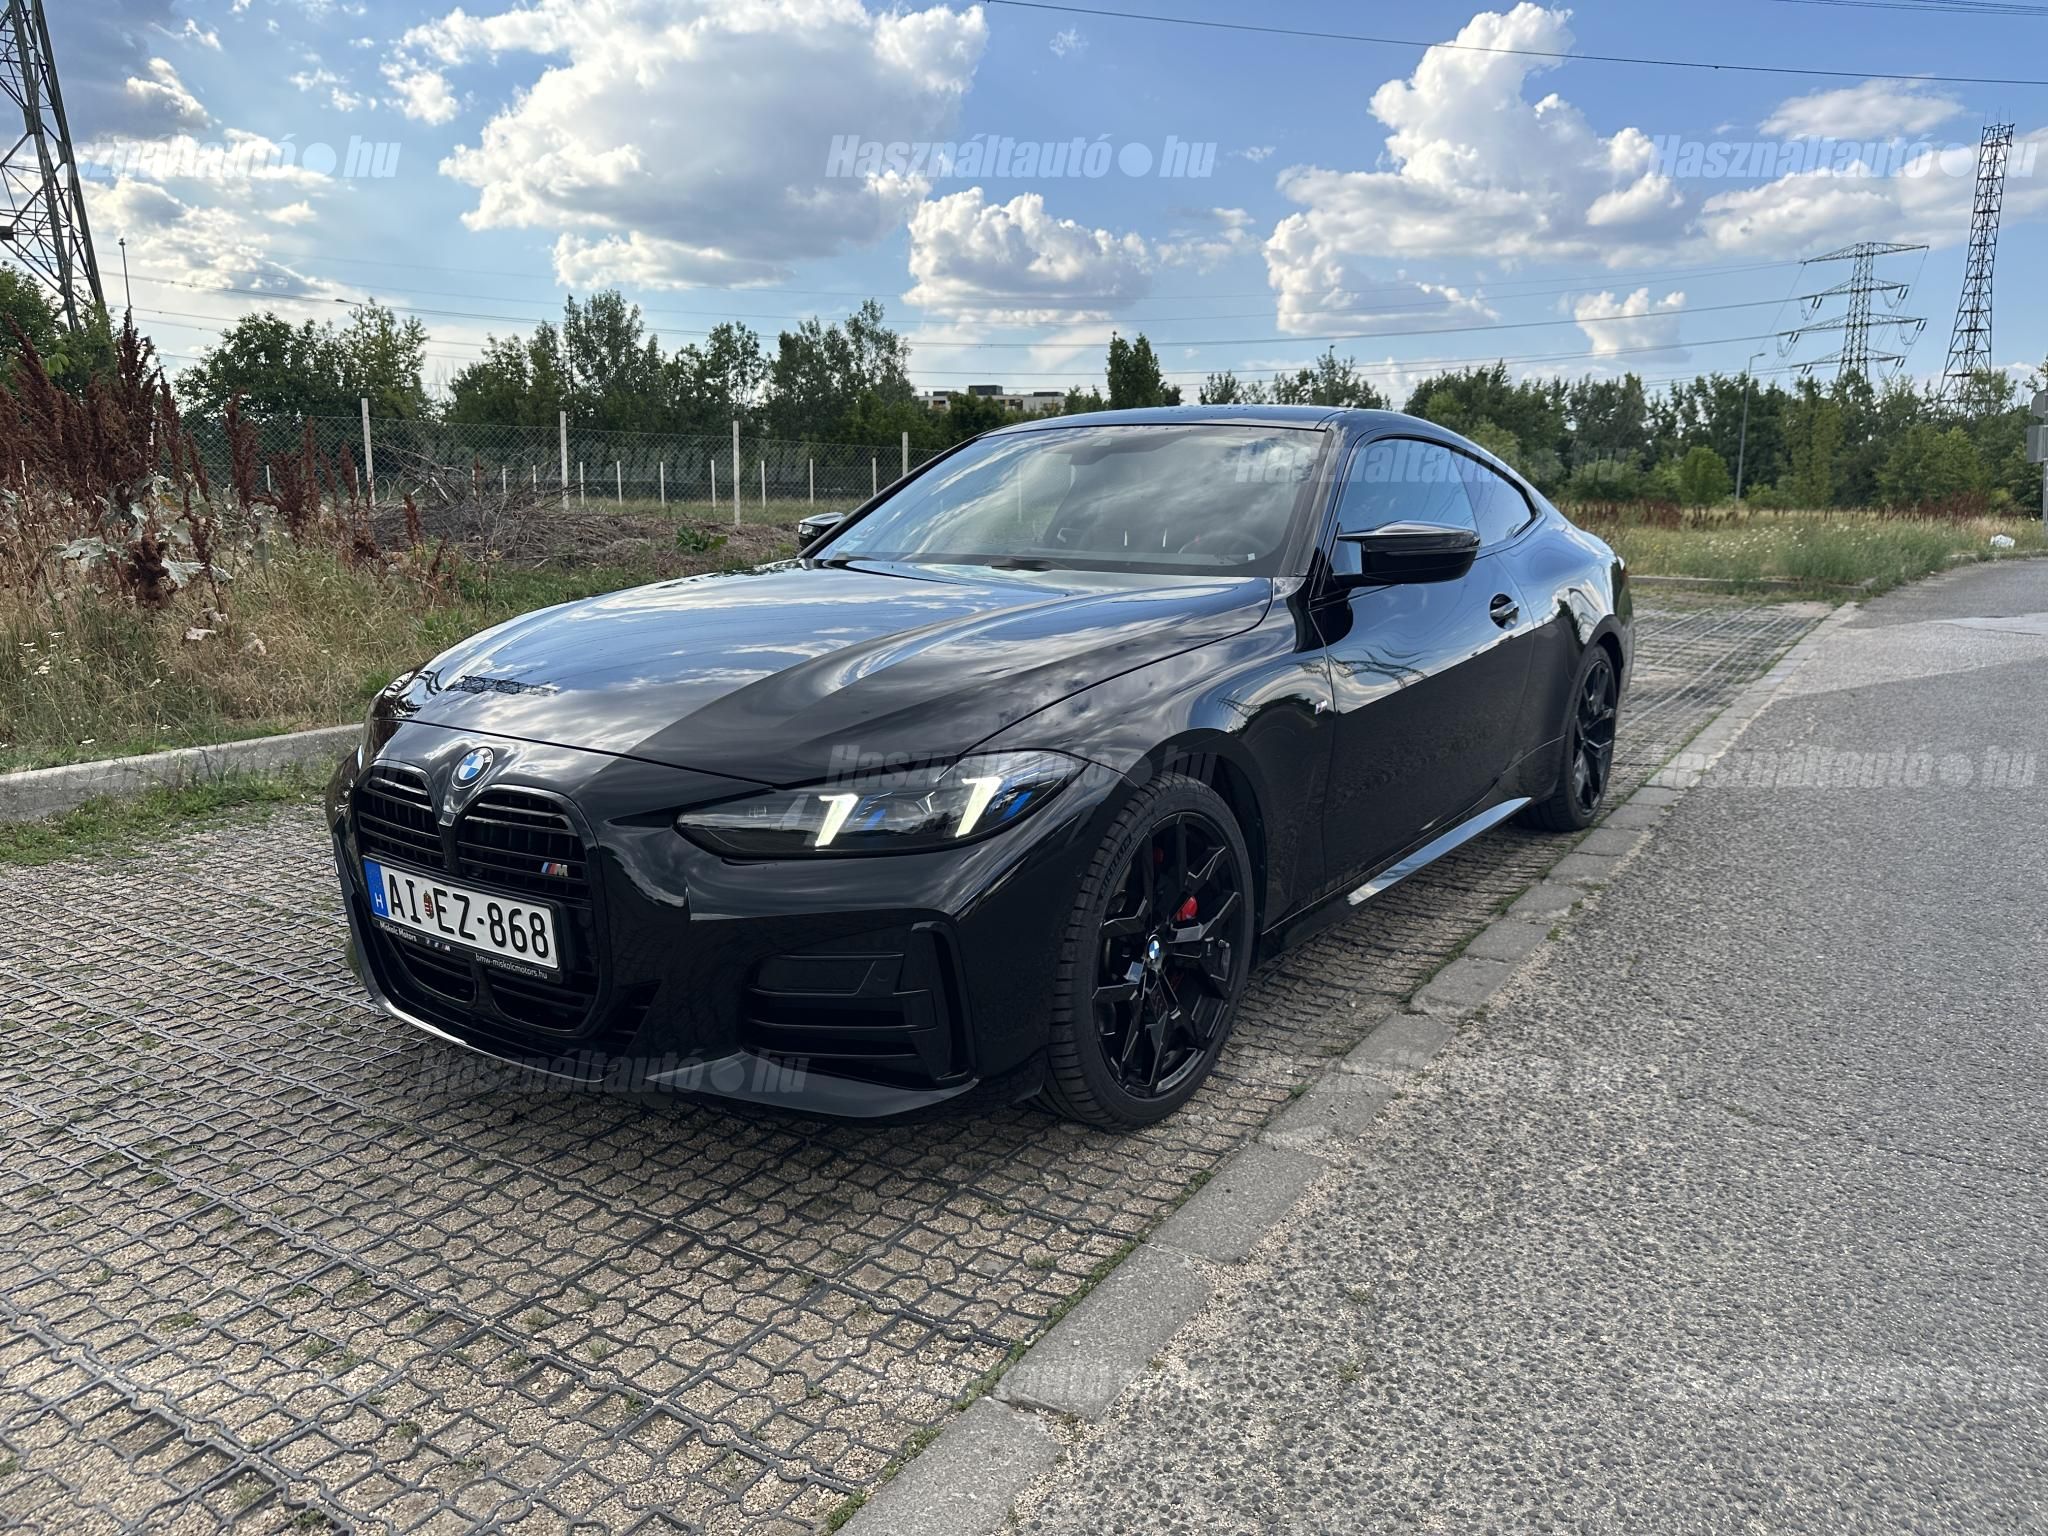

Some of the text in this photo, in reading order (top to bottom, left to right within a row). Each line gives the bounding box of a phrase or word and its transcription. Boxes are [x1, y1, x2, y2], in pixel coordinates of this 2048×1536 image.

[374, 872, 549, 959] H AI EZ-868
